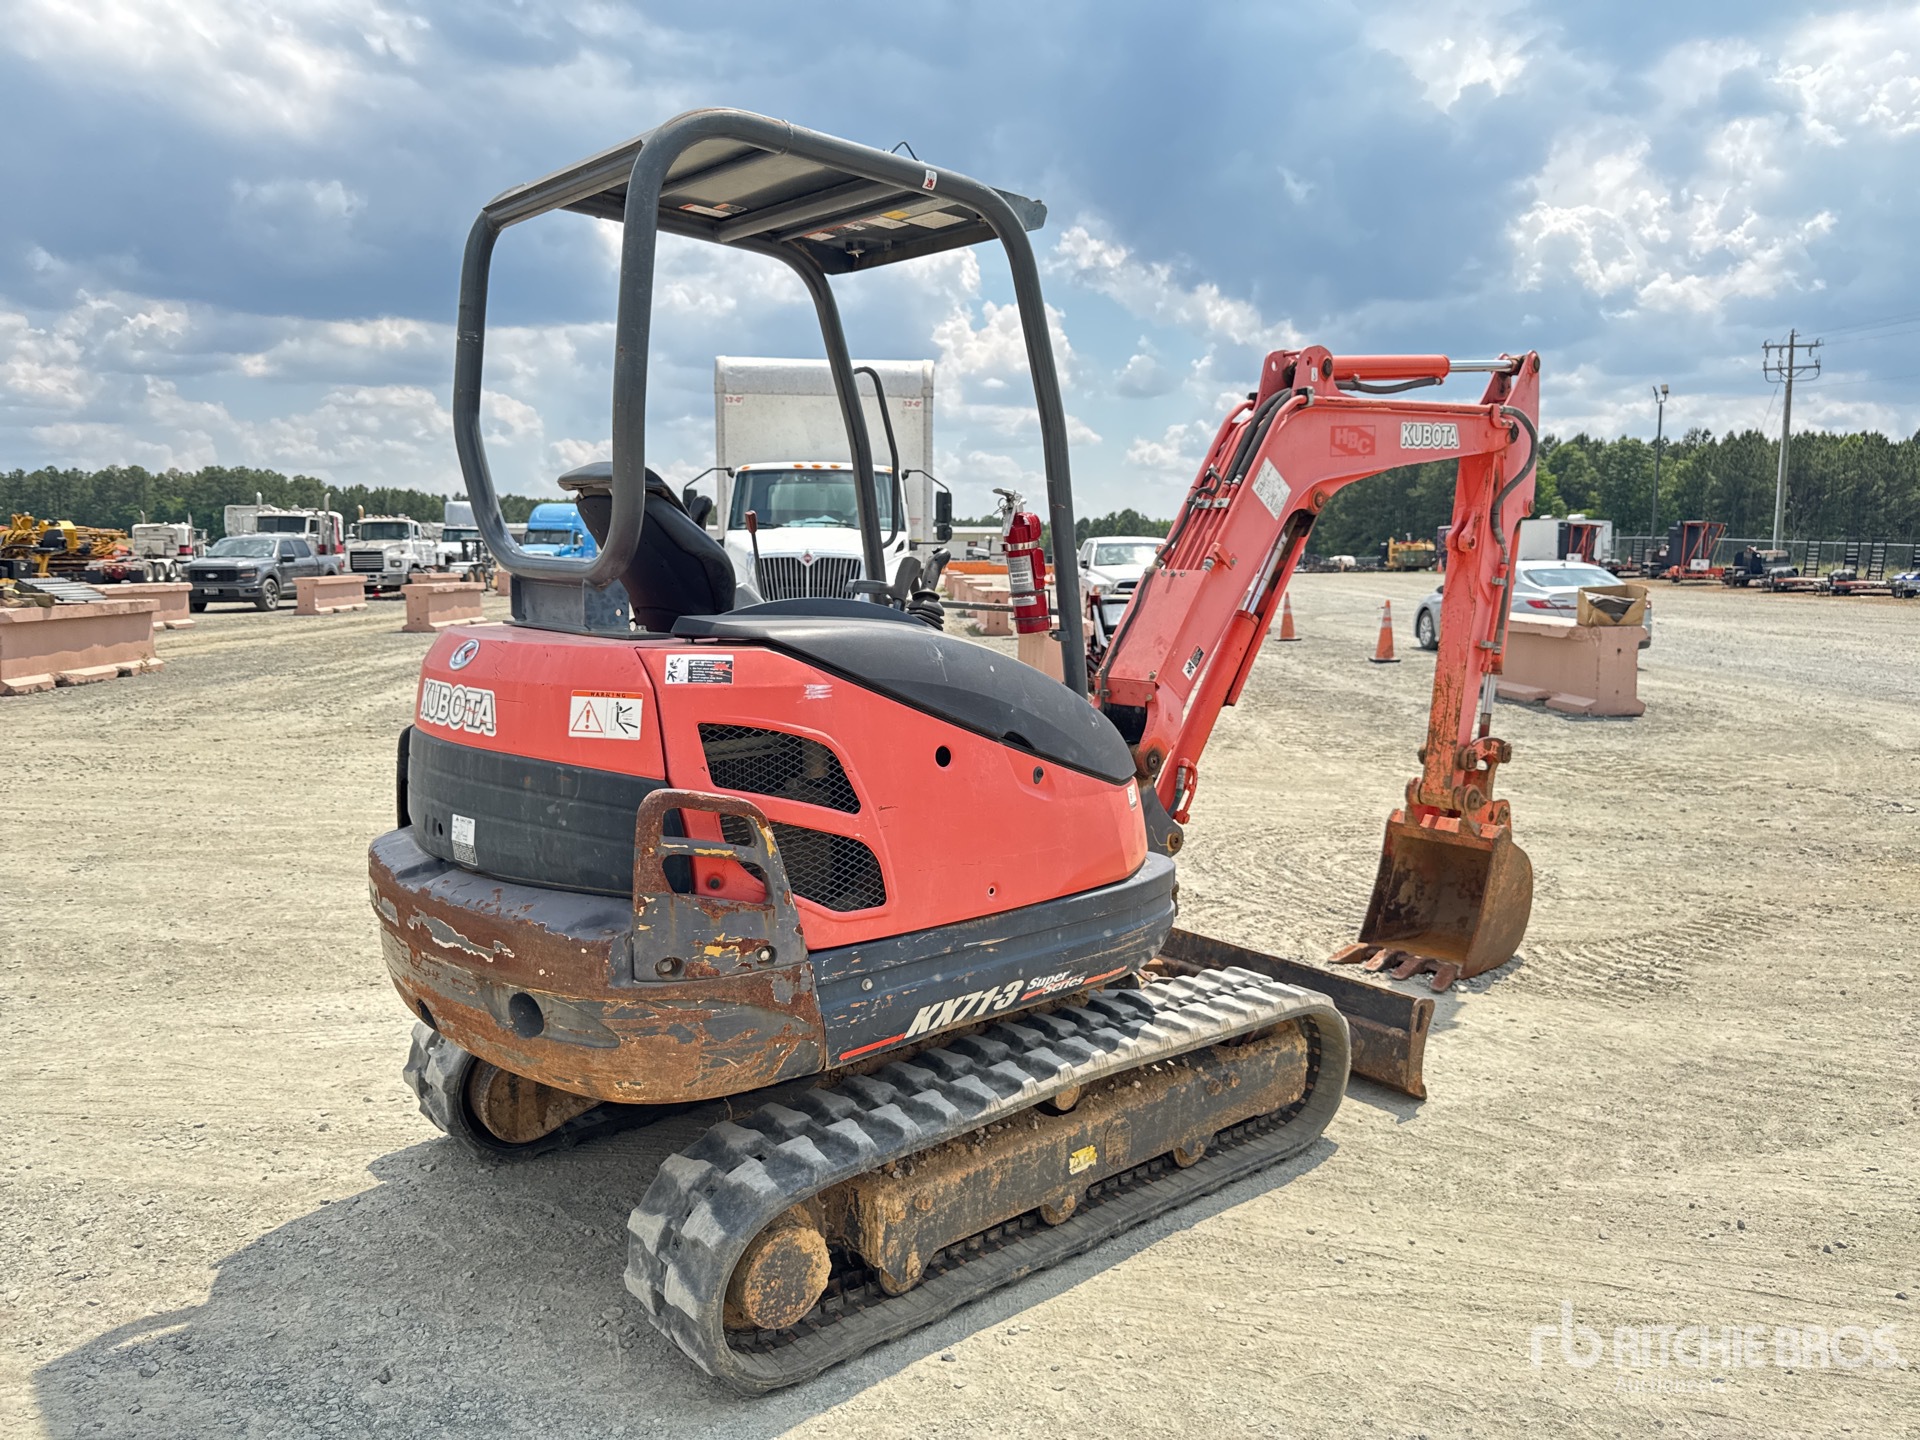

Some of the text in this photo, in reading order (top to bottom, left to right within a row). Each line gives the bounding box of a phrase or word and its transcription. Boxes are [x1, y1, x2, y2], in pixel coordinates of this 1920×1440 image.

[1334, 428, 1371, 454] HBC
[1401, 423, 1459, 448] KUBOTA
[421, 680, 496, 735] KUBOTA
[1026, 969, 1072, 991] Super
[1042, 974, 1086, 995] Series
[904, 980, 1024, 1039] KX71-3
